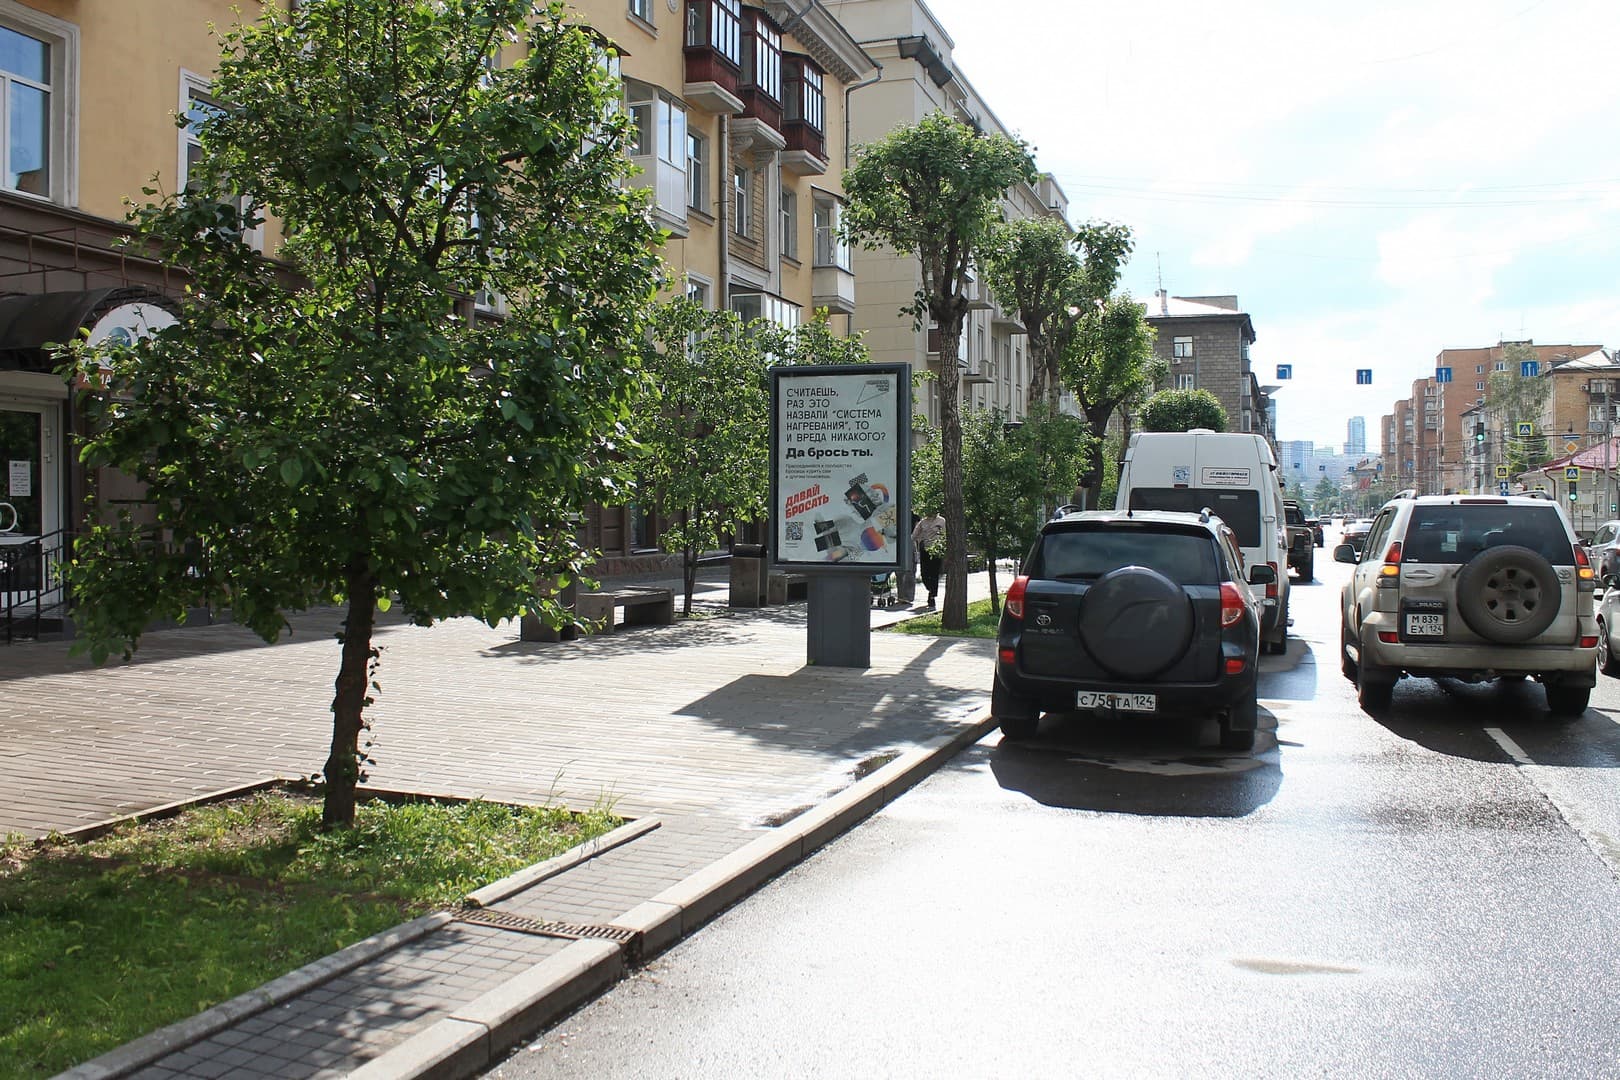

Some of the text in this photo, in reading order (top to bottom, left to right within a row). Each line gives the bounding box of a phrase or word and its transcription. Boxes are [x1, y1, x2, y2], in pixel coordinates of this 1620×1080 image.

[786, 387, 839, 397] СЧИТАЕШЬ,
[786, 399, 830, 408] РАЗ ЭТО
[786, 410, 828, 420] НАЗВАЛИ
[855, 421, 869, 430] ТО
[786, 432, 886, 442] И ВРЕДА НИКАКОГО?
[786, 447, 873, 459] Да брось ты.
[785, 483, 820, 509] ДАВАЙ
[785, 494, 830, 520] БРОСАТЬ
[1422, 616, 1438, 624] 839
[1411, 625, 1424, 634] ЕХ
[1134, 695, 1154, 706] 124
